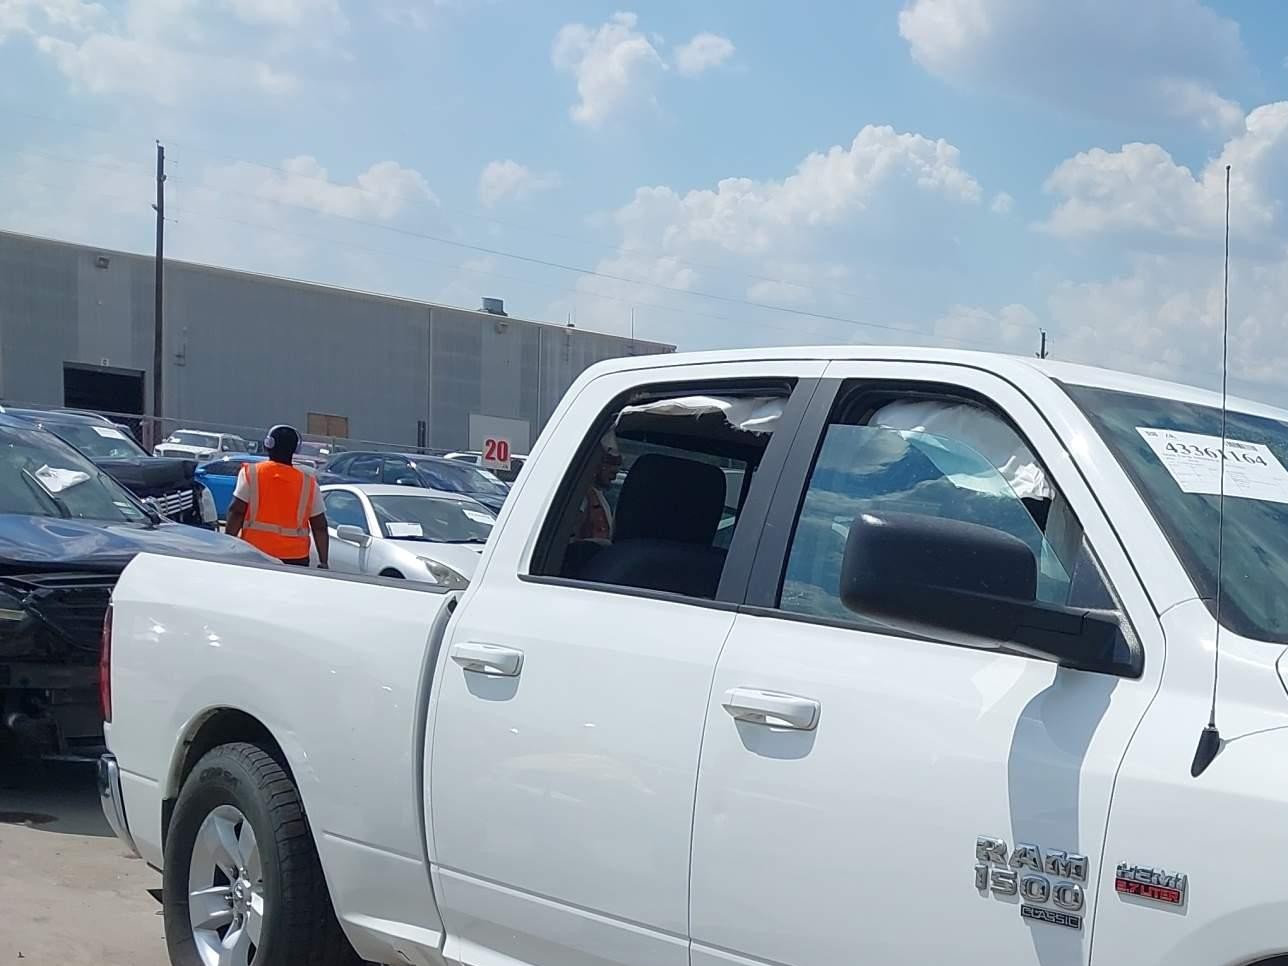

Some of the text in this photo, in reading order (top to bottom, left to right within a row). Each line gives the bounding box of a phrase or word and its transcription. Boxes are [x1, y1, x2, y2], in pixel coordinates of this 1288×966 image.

[486, 440, 508, 461] 20
[1165, 443, 1268, 467] 43361164
[976, 835, 1089, 881] RAM
[974, 864, 1084, 911] 1500
[1116, 862, 1187, 890] HEMI
[1141, 884, 1180, 903] LITER
[1022, 906, 1080, 929] CLASSIC
